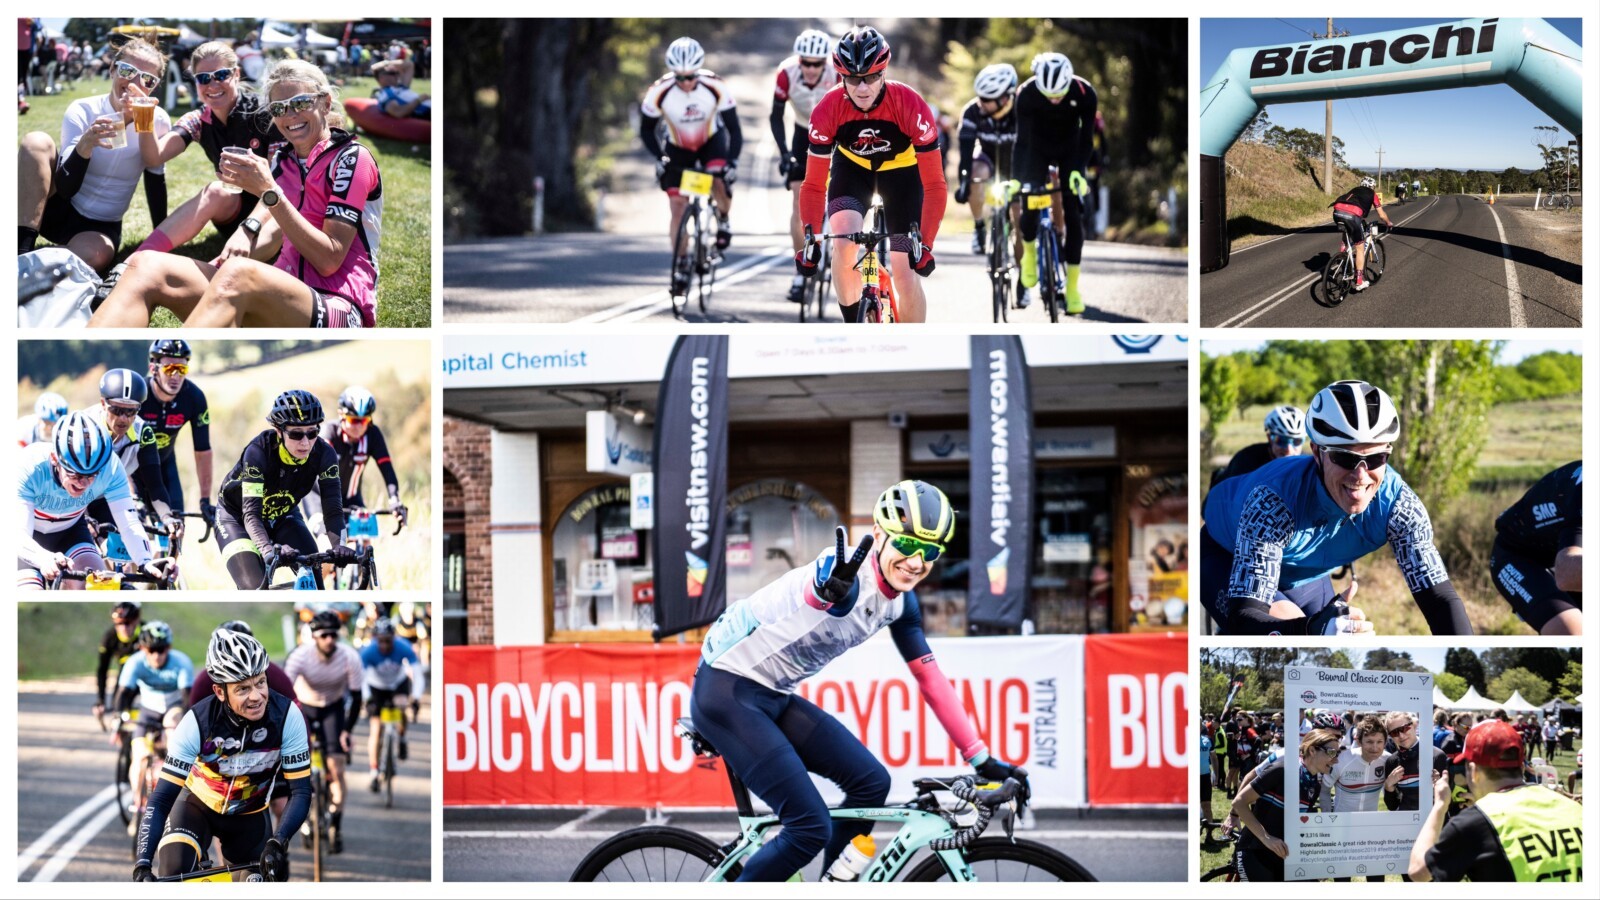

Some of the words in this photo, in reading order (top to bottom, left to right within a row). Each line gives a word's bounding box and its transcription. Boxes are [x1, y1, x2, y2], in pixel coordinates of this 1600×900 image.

[1250, 18, 1499, 79] Bianchi
[502, 350, 587, 369] Chemist
[686, 357, 709, 550] visitnsw.com
[1532, 502, 1558, 521] SMP
[1505, 563, 1524, 582] SOUTH
[1500, 568, 1533, 604] MELBOURNE
[1316, 671, 1348, 682] Bowral
[1350, 672, 1379, 683] Classic
[1380, 675, 1404, 685] 2019
[1320, 691, 1358, 699] BowralClassic
[1035, 677, 1056, 769] AUSTRALIA
[143, 806, 155, 820] DR
[140, 822, 151, 854] JONES
